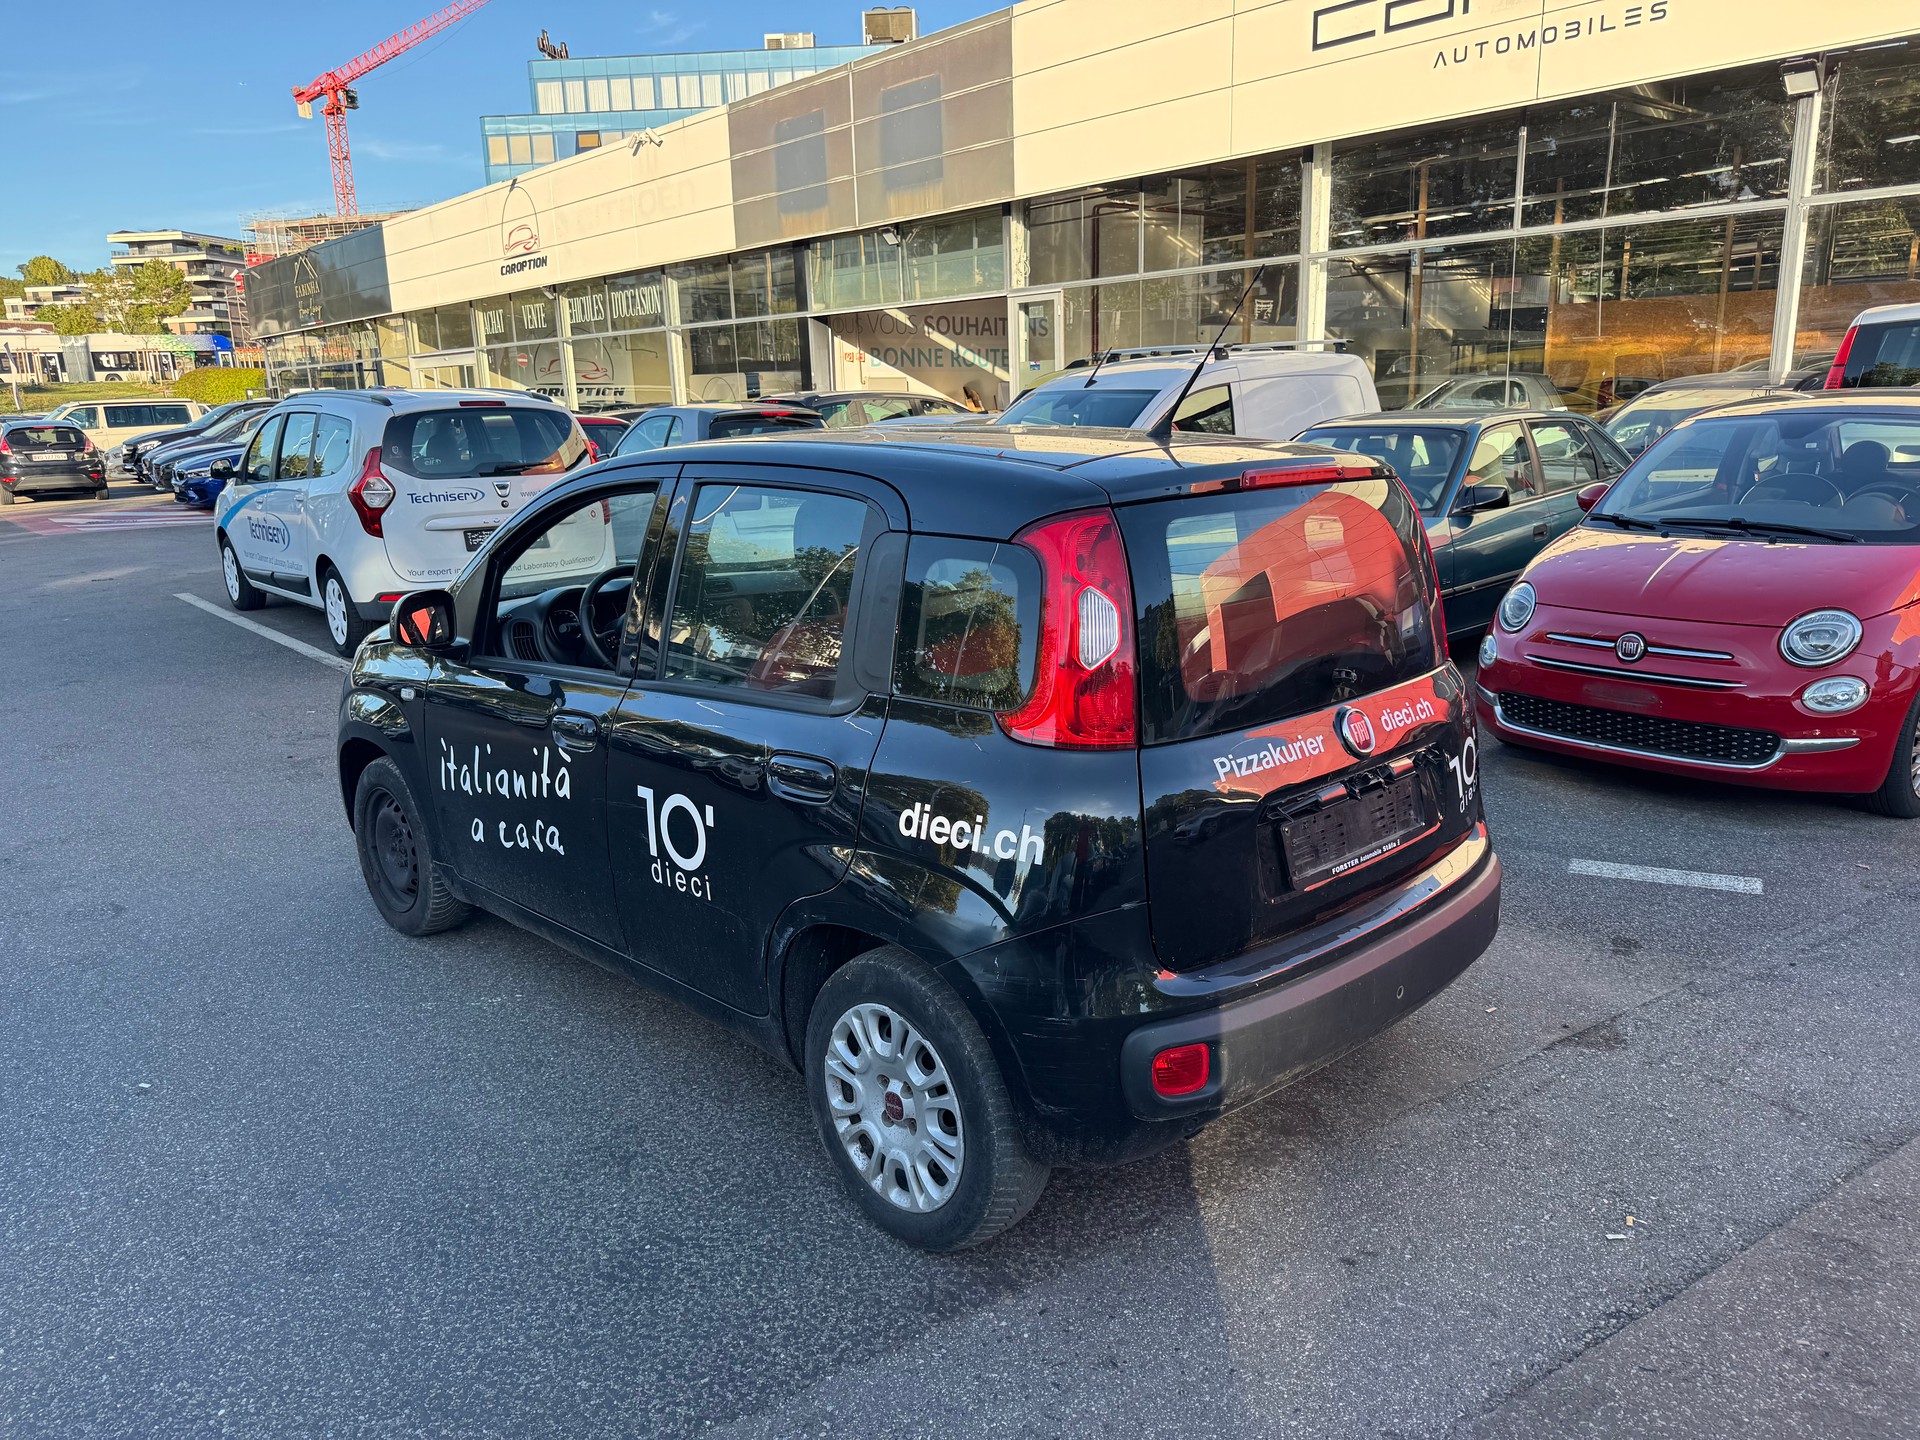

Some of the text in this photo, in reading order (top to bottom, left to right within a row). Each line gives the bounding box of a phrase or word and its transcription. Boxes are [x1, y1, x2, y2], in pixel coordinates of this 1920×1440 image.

[1433, 1, 1668, 69] AUTOMOBILES
[500, 255, 548, 276] CAROPTION
[521, 302, 548, 330] VENTE
[611, 285, 662, 319] D'OCCASION
[832, 314, 1049, 337] OUS VOUS SOUHAITNS
[870, 346, 944, 368] BONNE
[951, 347, 1009, 368] ROUTE
[407, 491, 479, 504] Techniserv
[247, 516, 286, 545] Techniserv
[407, 569, 425, 577] Your
[427, 568, 452, 577] expert
[523, 560, 559, 570] Laboratory
[560, 555, 596, 567] Qualification
[1622, 641, 1639, 654] FIAT
[1380, 697, 1434, 732] dieci.ch
[1350, 719, 1371, 744] FIAT
[1213, 734, 1325, 783] Pizzakurier
[471, 817, 565, 856] a casa
[898, 801, 1045, 866] dieci.ch
[1331, 858, 1359, 875] FORSTER
[1360, 848, 1382, 863] Automobile
[651, 858, 712, 901] dieci
